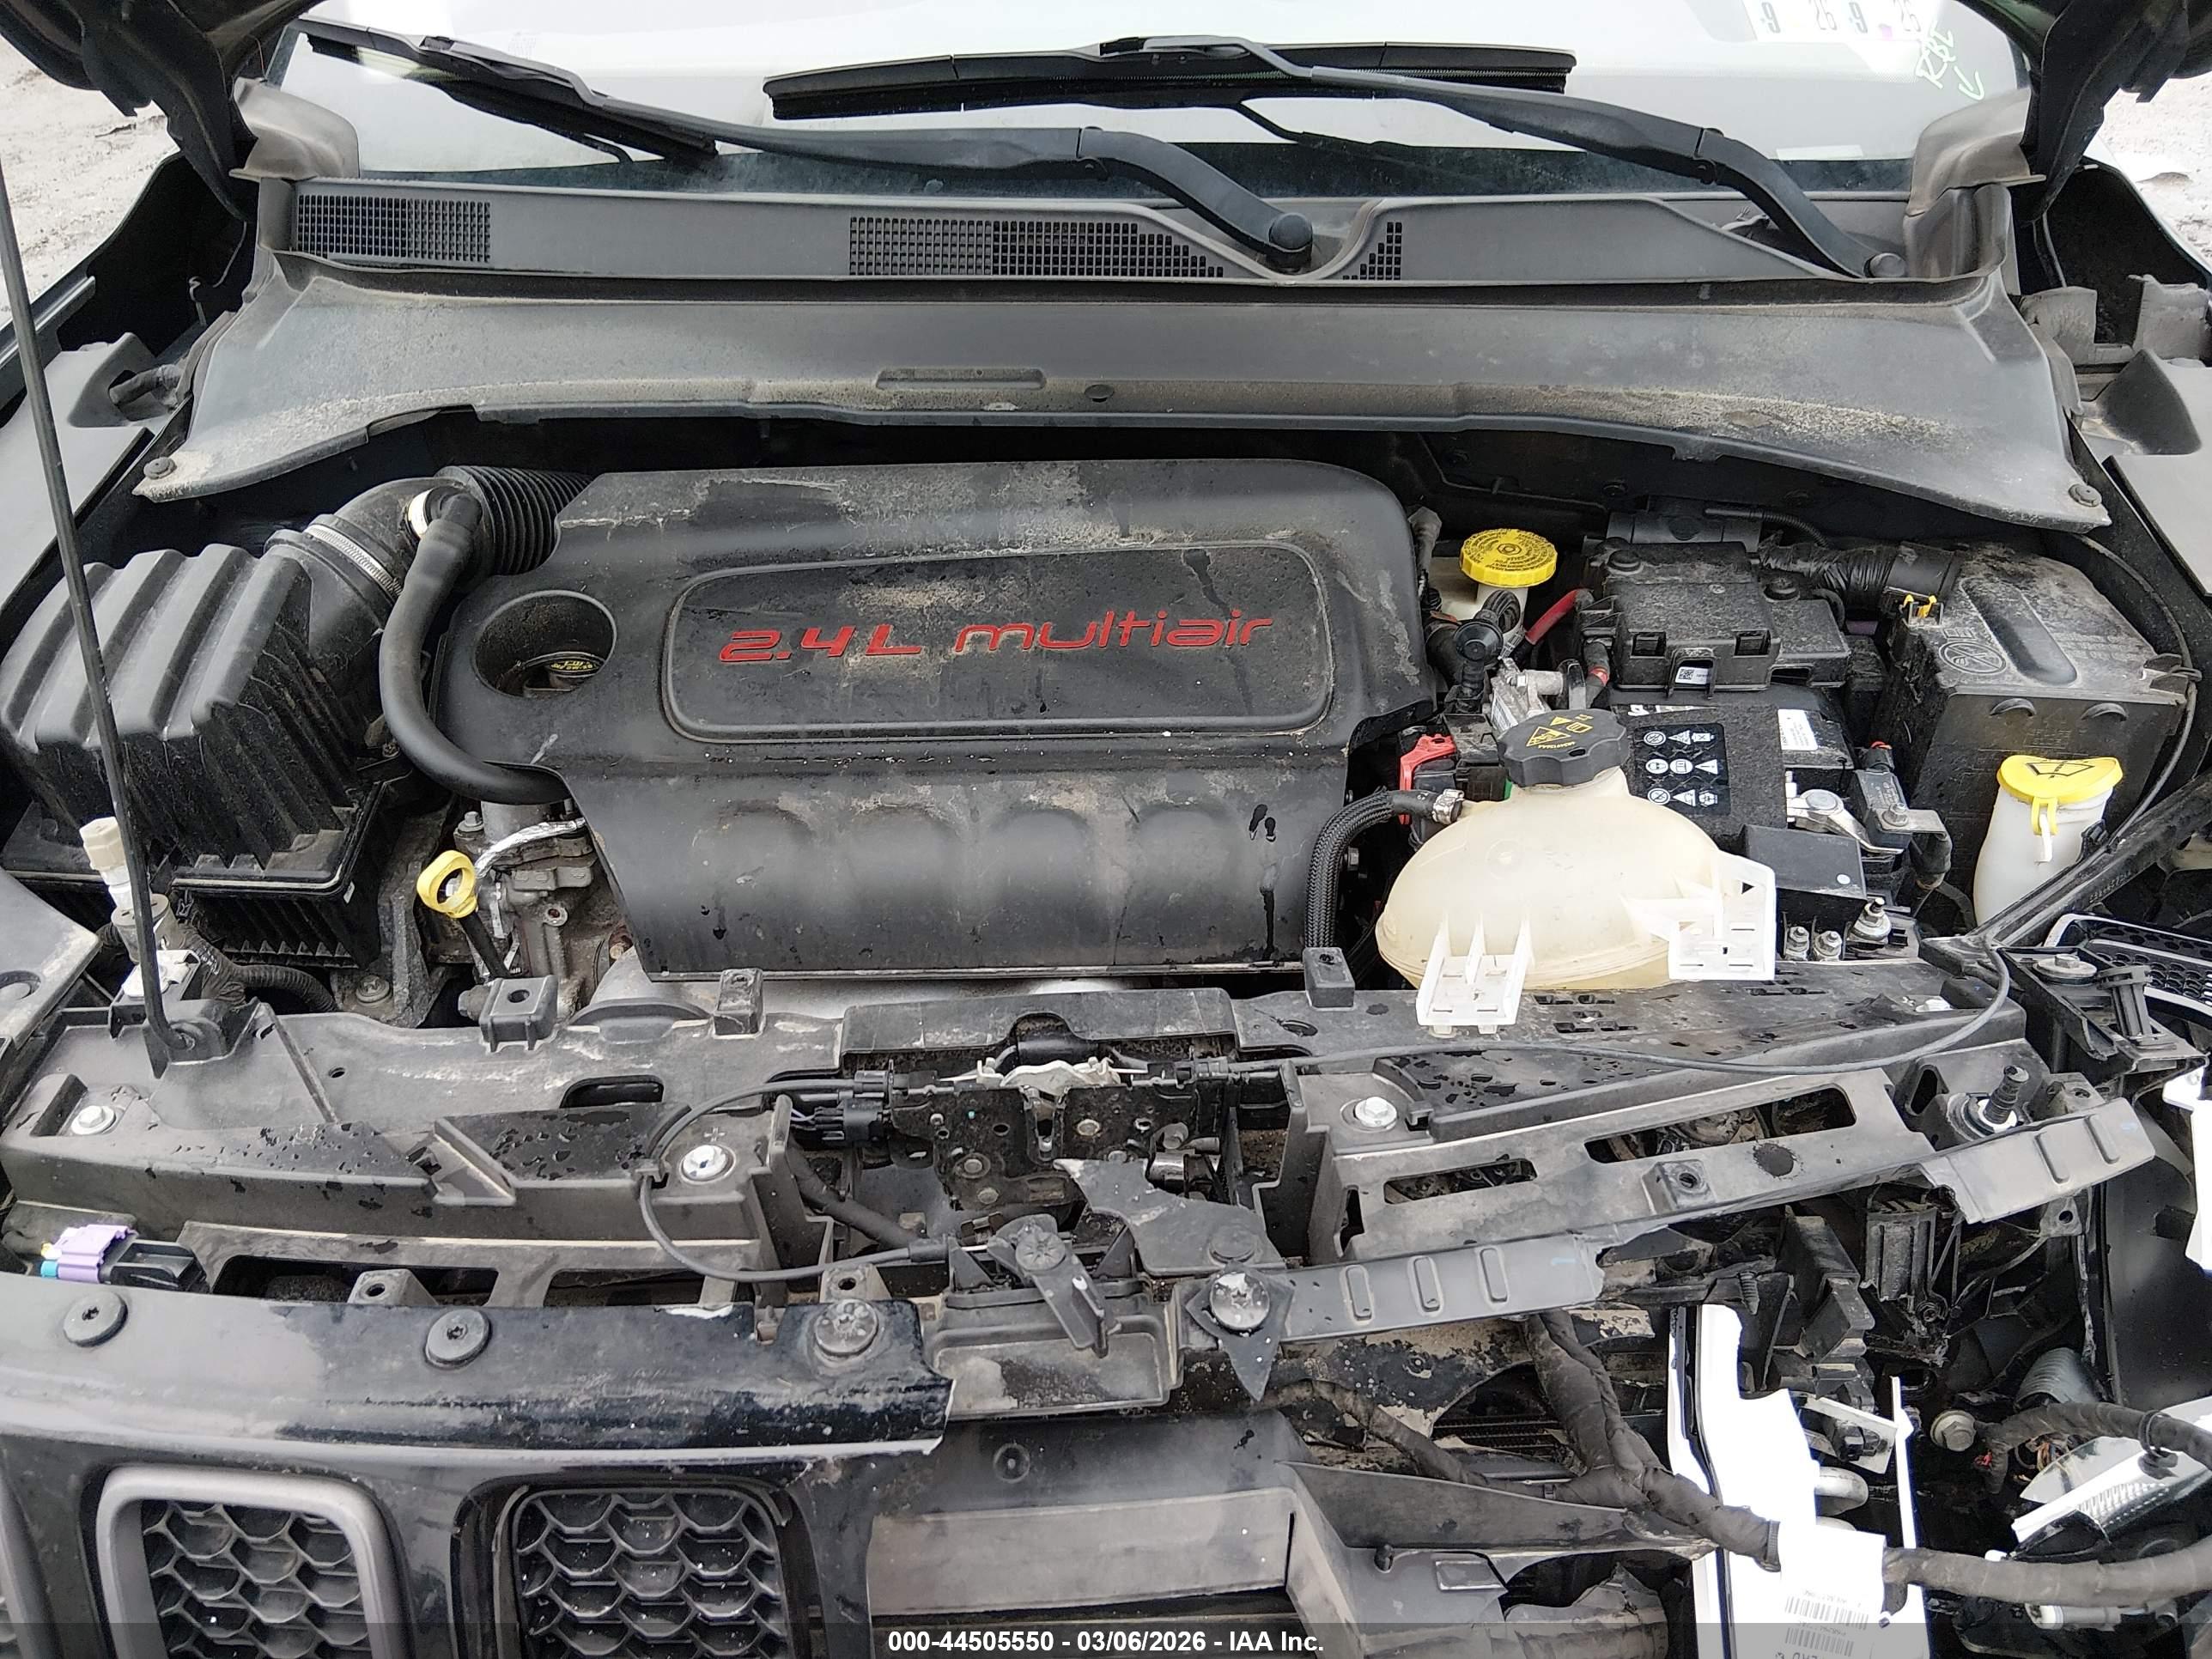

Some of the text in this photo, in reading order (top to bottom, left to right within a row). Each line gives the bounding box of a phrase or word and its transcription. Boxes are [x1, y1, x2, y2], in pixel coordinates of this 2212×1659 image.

[1760, 1, 1782, 33] 9
[1848, 1, 1869, 33] 9
[718, 610, 1273, 663] 2.4L multiair
